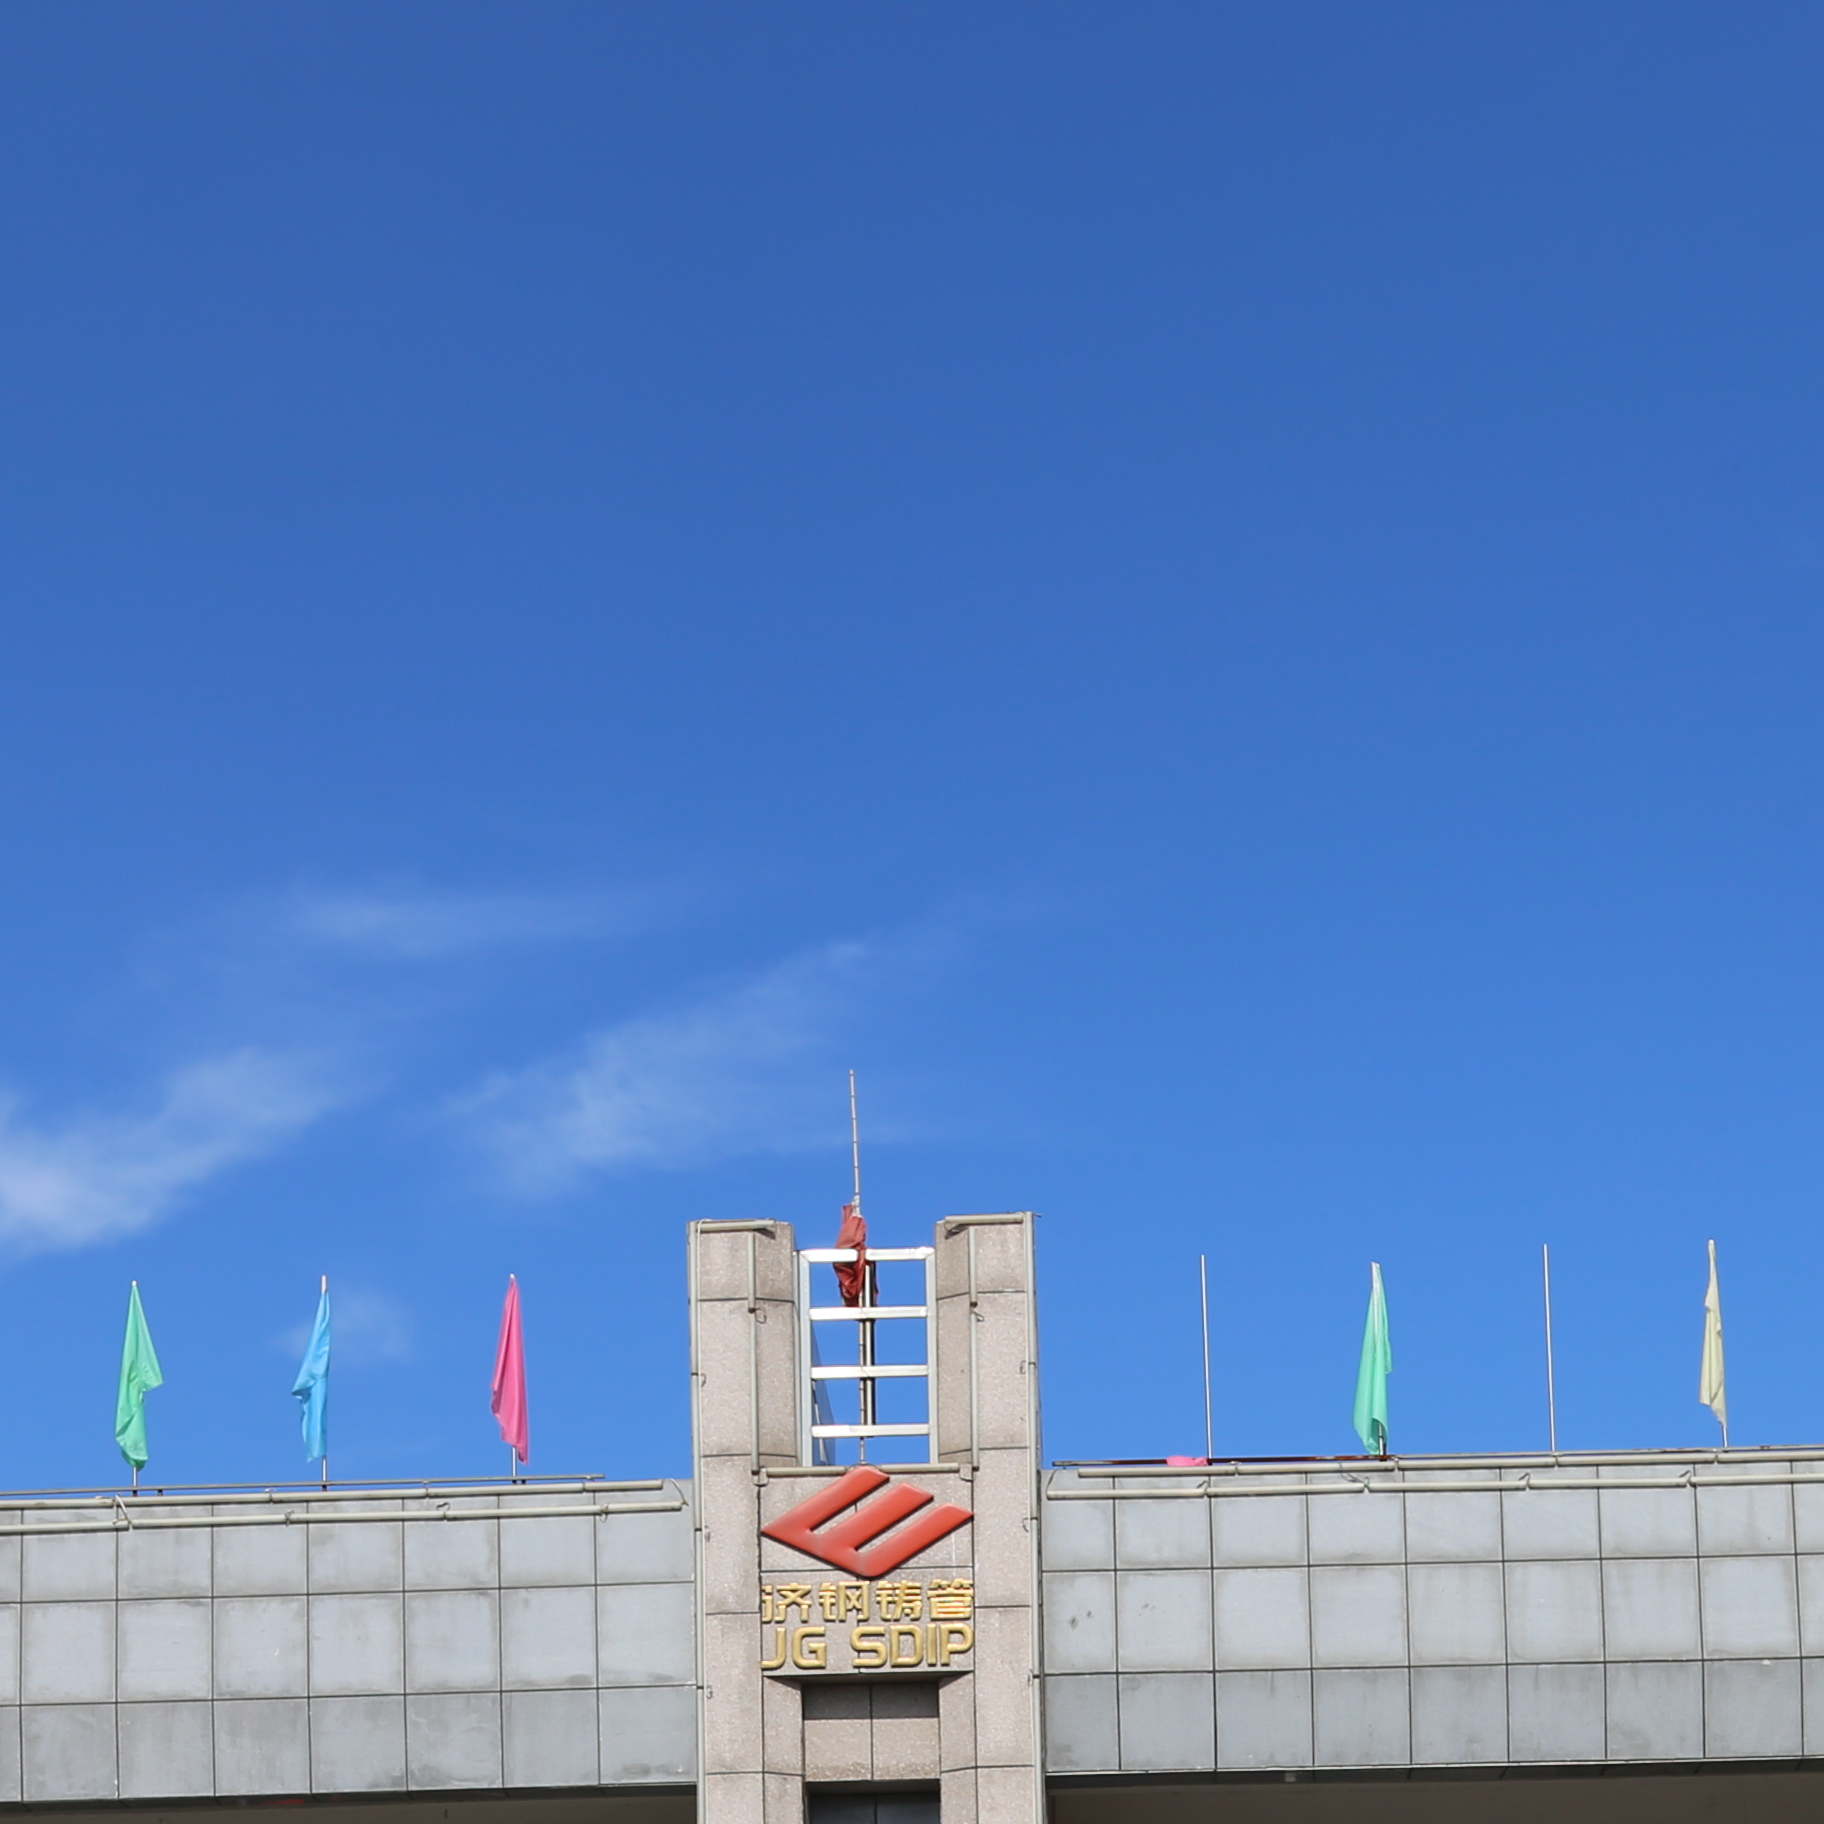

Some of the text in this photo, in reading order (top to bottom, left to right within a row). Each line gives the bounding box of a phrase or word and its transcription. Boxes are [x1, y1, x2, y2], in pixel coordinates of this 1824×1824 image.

[760, 1578, 974, 1624] 济钢铸管
[760, 1623, 974, 1670] JG SDIP
